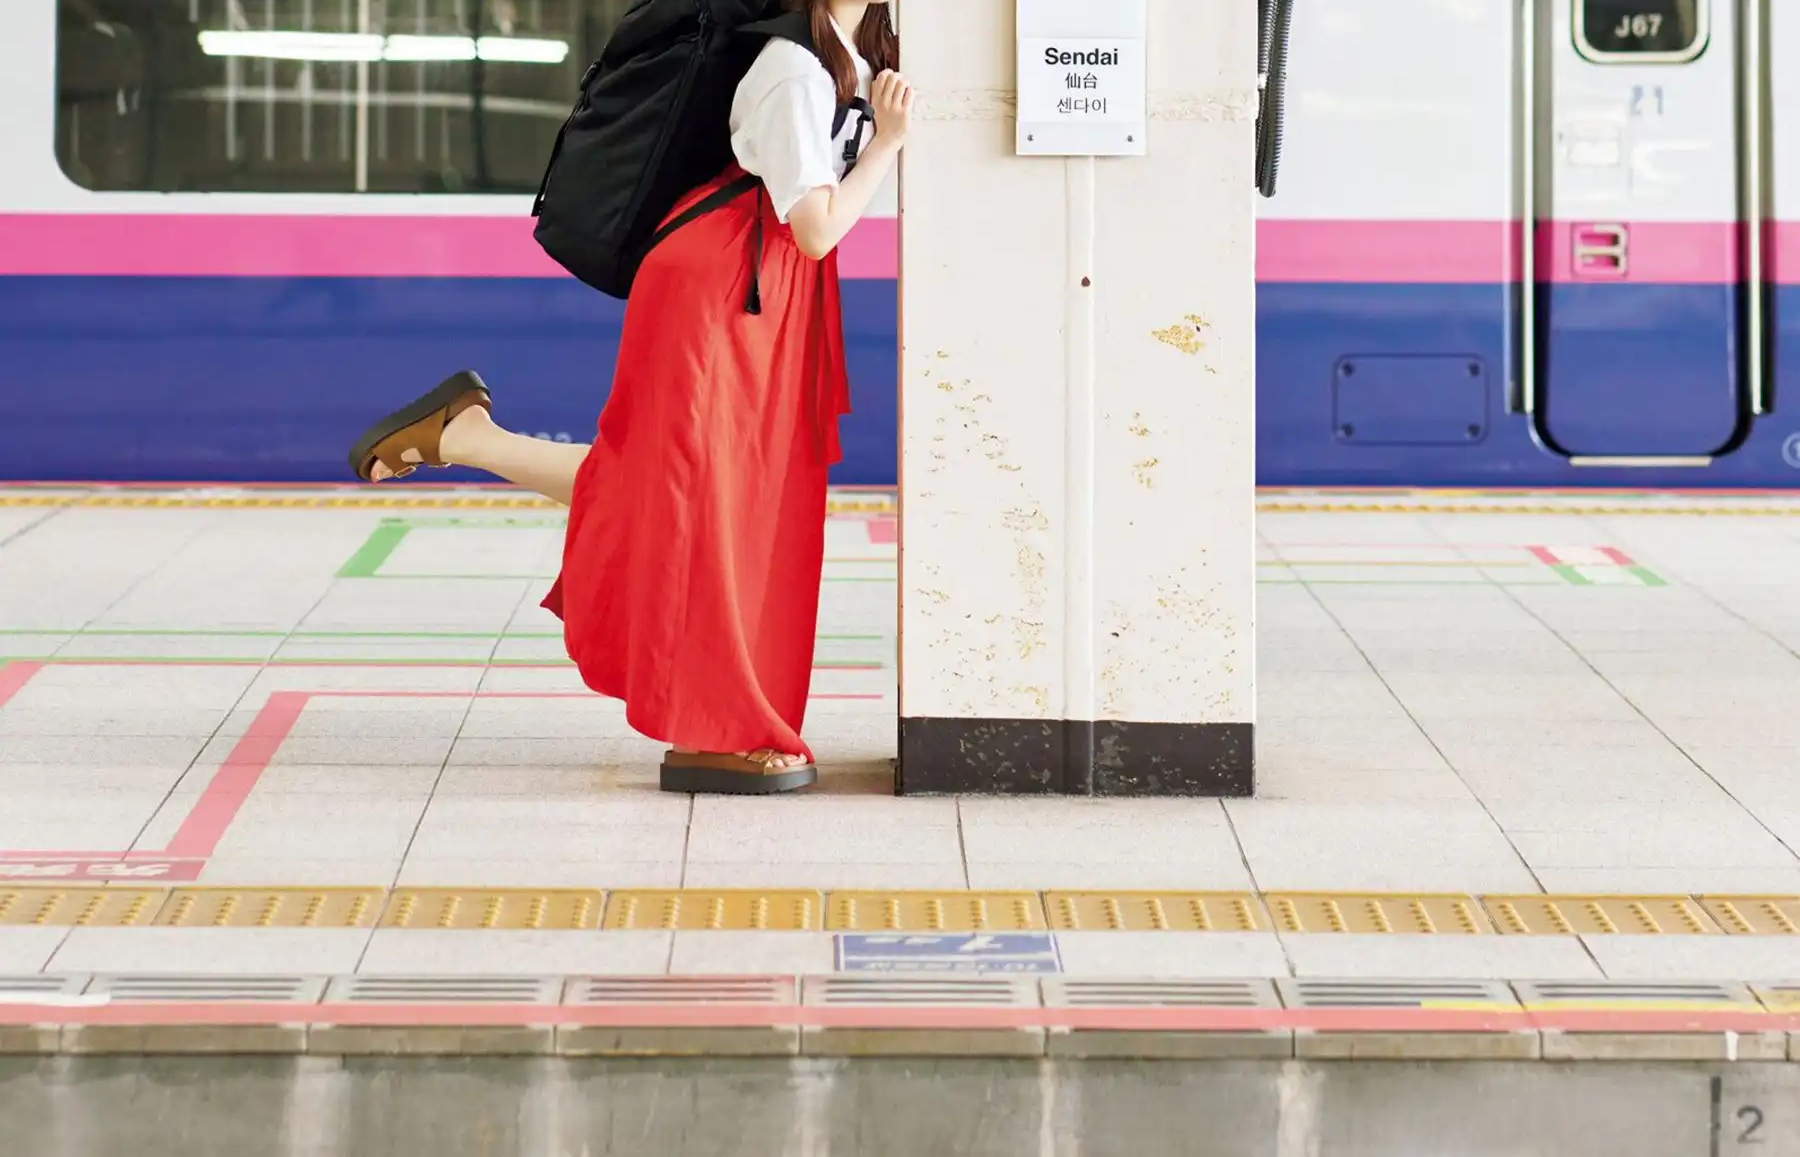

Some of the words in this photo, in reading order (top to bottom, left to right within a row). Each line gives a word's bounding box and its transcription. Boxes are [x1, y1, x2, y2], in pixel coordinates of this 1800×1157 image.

[1614, 13, 1663, 38] J67
[1044, 47, 1119, 66] Sendai
[1064, 72, 1098, 90] 仙台
[1056, 97, 1107, 115] 센다이
[1736, 1104, 1765, 1144] 2
